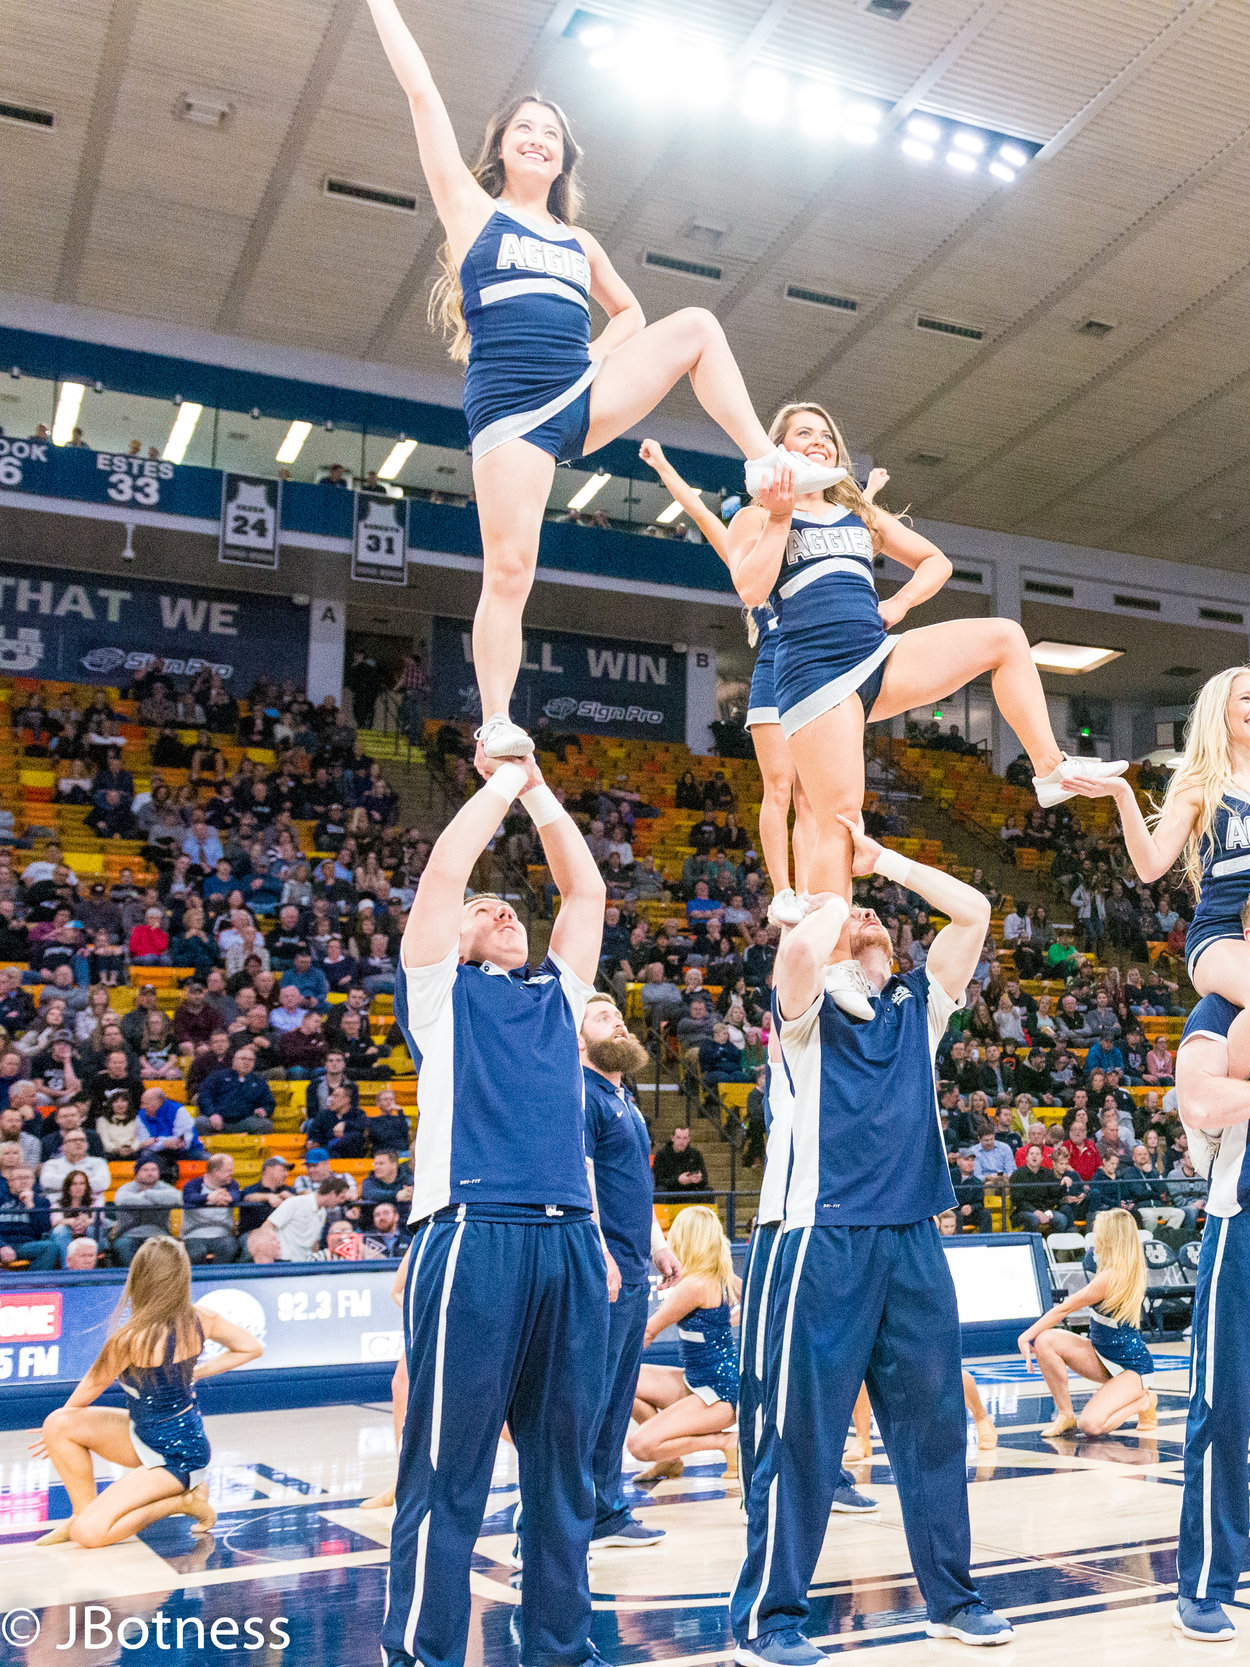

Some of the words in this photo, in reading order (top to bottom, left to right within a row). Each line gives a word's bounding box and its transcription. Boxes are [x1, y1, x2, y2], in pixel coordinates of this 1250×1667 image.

[496, 232, 592, 294] AGGIE
[96, 453, 174, 480] ESTES
[107, 472, 160, 505] 33
[232, 514, 268, 538] 24
[366, 535, 395, 555] 31
[159, 595, 238, 636] WE
[320, 606, 337, 624] A
[461, 632, 563, 673] LL
[586, 648, 668, 685] WIN
[696, 653, 709, 668] B
[277, 1290, 332, 1321] 92.3
[337, 1288, 372, 1319] FM
[18, 1345, 60, 1378] FM
